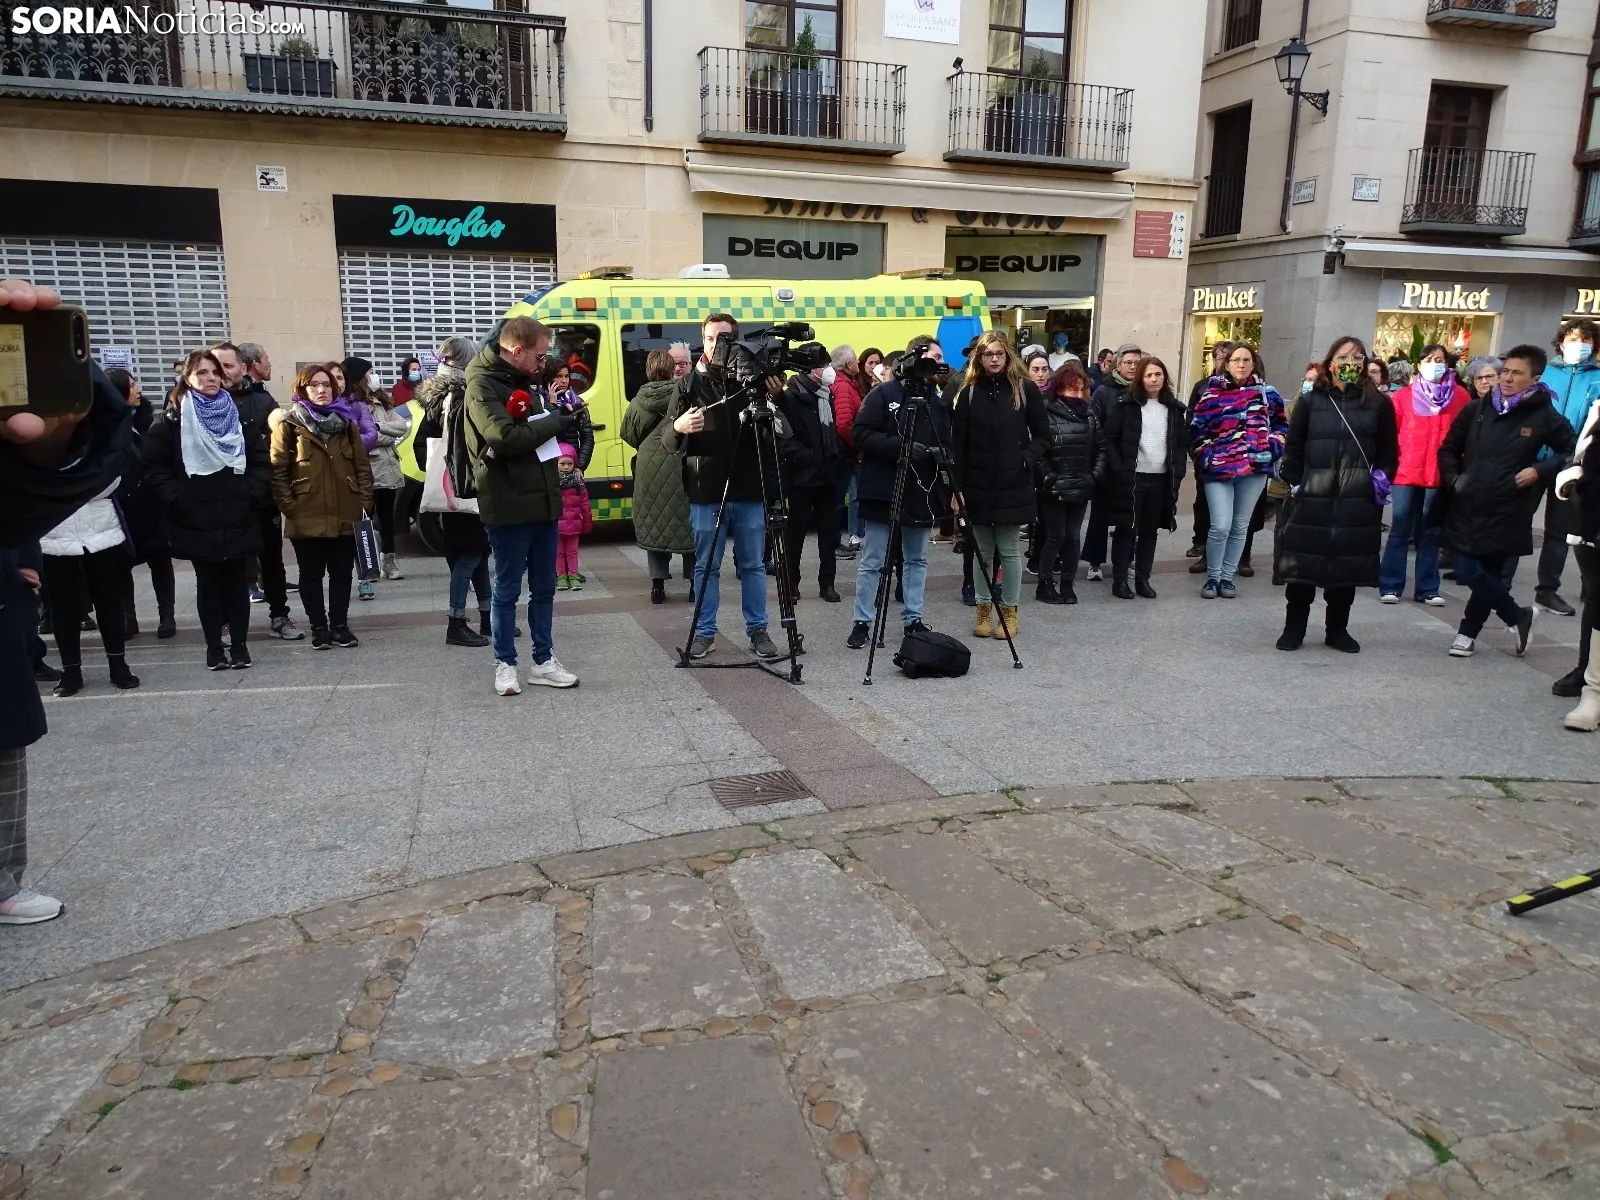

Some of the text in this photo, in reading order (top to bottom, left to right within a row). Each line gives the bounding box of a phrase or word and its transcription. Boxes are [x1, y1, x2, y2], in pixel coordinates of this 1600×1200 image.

[890, 12, 957, 27] VIRGINIA SANZ
[389, 204, 506, 247] Douglas
[728, 236, 860, 261] DEQUIP
[955, 254, 1082, 274] DEQUIP
[1192, 285, 1256, 311] Phuket
[1400, 282, 1490, 310] Phuket
